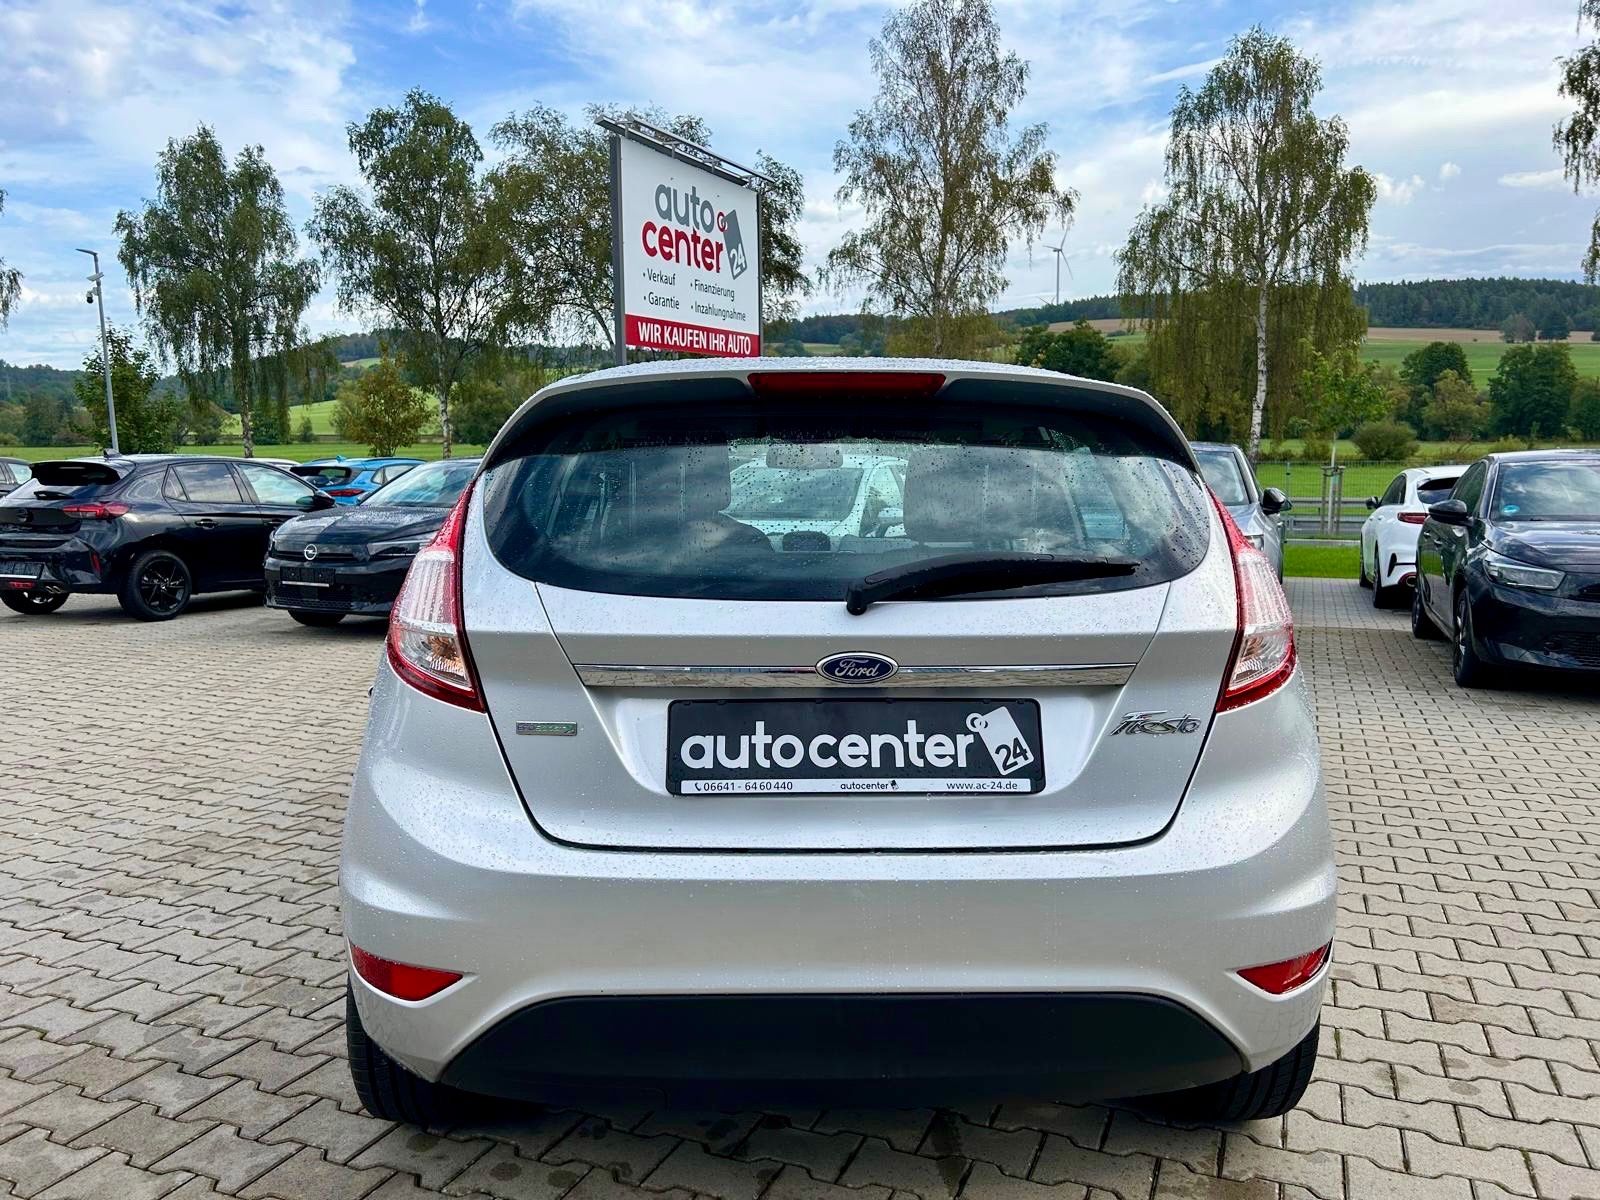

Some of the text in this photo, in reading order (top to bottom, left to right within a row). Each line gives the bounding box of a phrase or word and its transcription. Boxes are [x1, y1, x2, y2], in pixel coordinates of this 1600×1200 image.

[655, 183, 715, 234] auto
[642, 221, 724, 273] center
[730, 243, 746, 275] 24
[647, 268, 676, 286] Verkauf
[648, 292, 680, 310] Garantie
[694, 279, 735, 302] Finanzierung
[694, 301, 746, 322] Inzahlungnahme
[638, 321, 751, 355] WIR KAUFEN IHR AUTO
[834, 658, 880, 677] Ford
[680, 719, 974, 769] autocenter
[995, 737, 1029, 771] 24
[840, 781, 888, 790] autocenter
[946, 781, 1018, 790] www.ac-24.de
